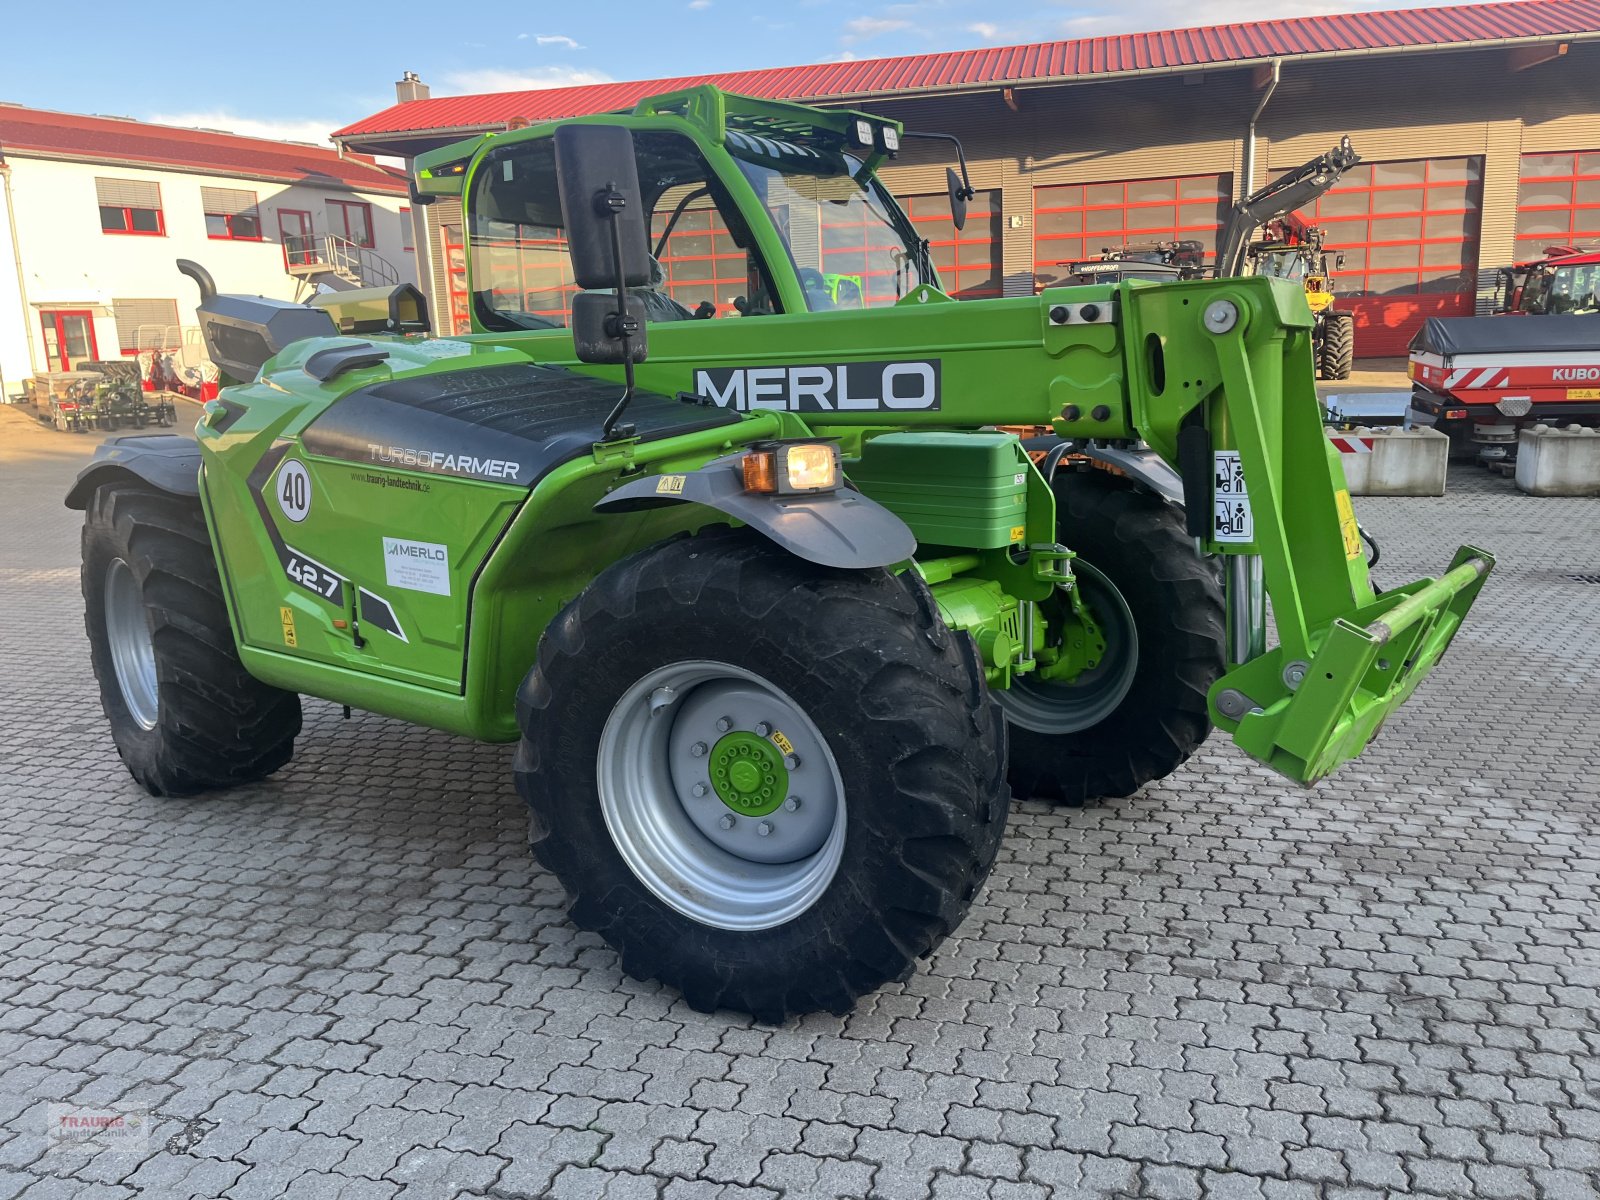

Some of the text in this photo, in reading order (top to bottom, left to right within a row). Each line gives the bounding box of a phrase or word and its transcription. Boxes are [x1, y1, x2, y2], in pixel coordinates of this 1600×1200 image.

[697, 362, 936, 411] MERLO
[367, 443, 520, 480] TURBOFARMER
[283, 472, 306, 511] 40
[399, 544, 445, 561] MERLO
[286, 557, 339, 598] 42.7
